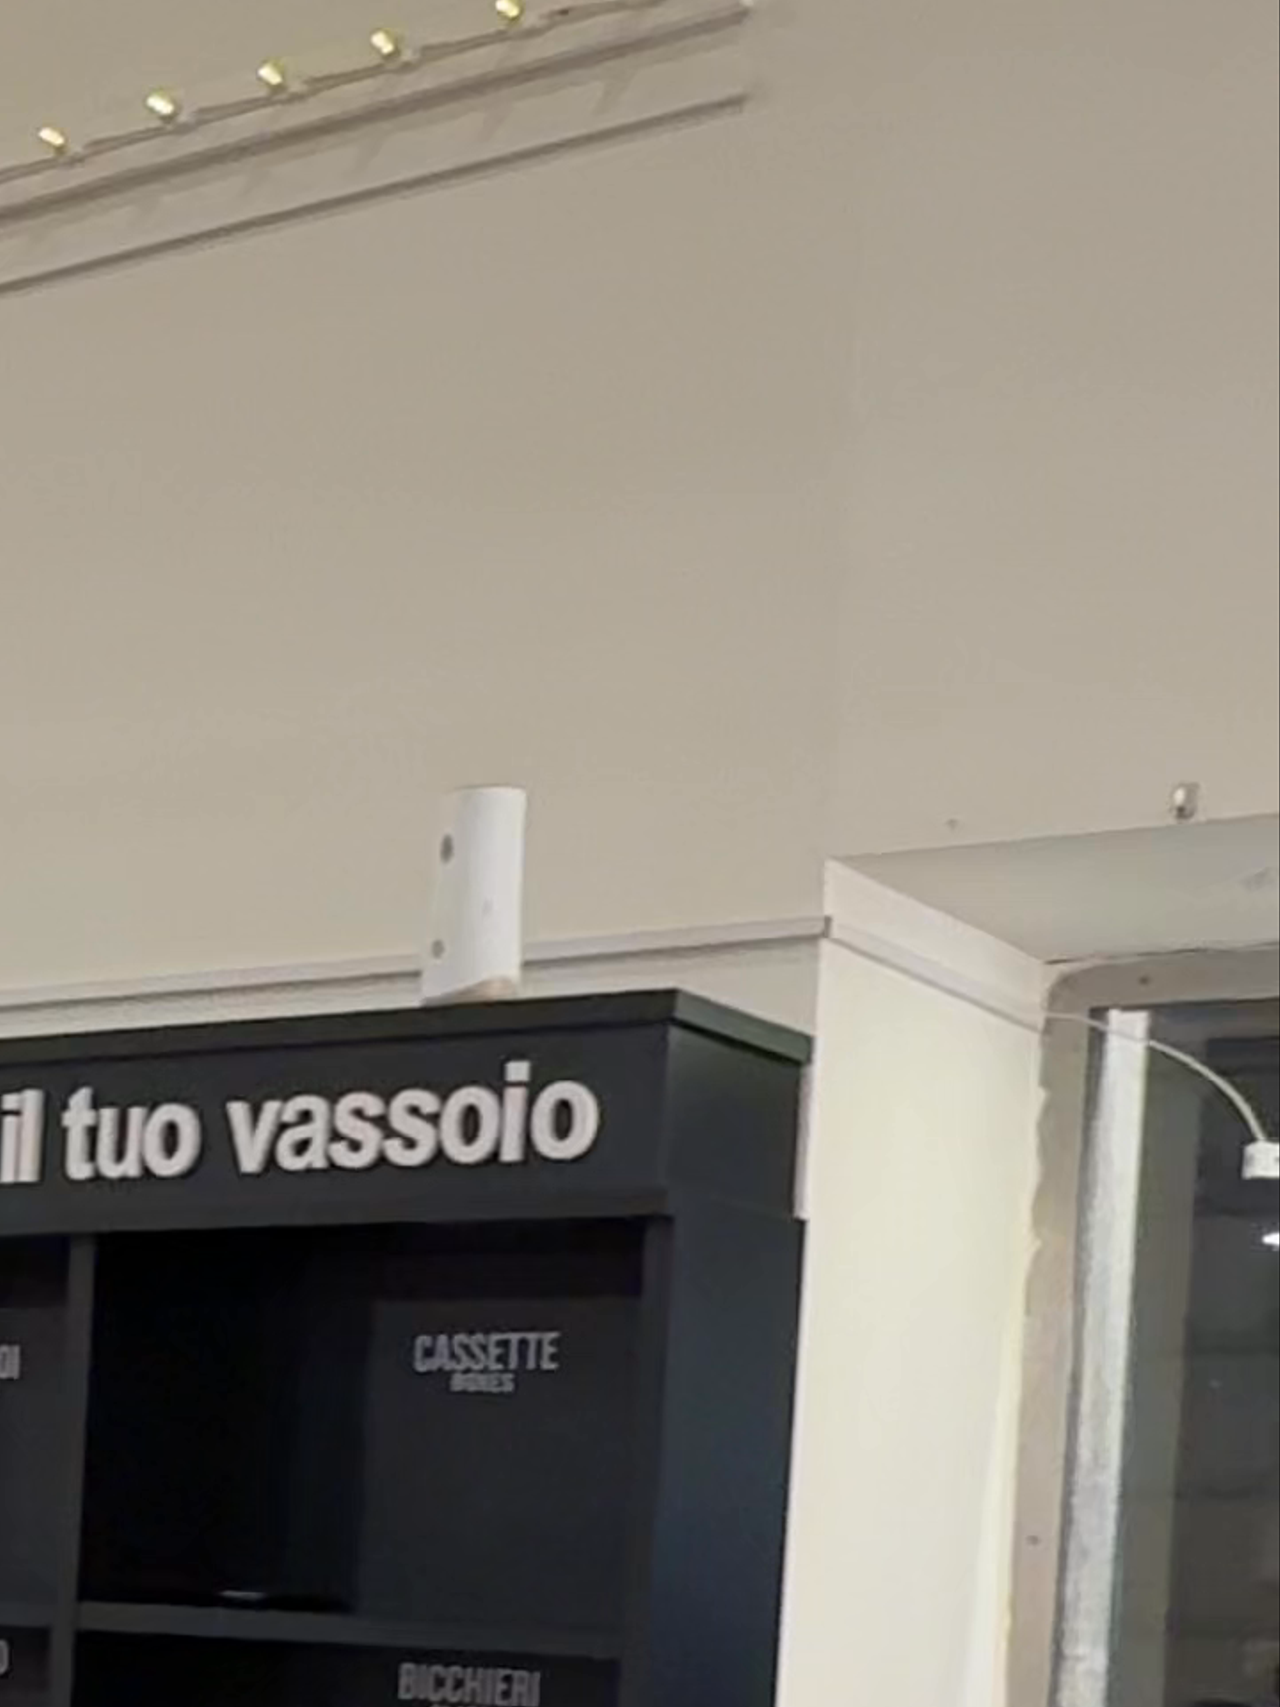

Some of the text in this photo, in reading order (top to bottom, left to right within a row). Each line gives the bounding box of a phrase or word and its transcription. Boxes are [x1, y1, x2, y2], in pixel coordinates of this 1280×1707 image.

[62, 1085, 203, 1180] tuo
[227, 1060, 602, 1174] vassoio
[412, 1331, 561, 1373] CASSETTE
